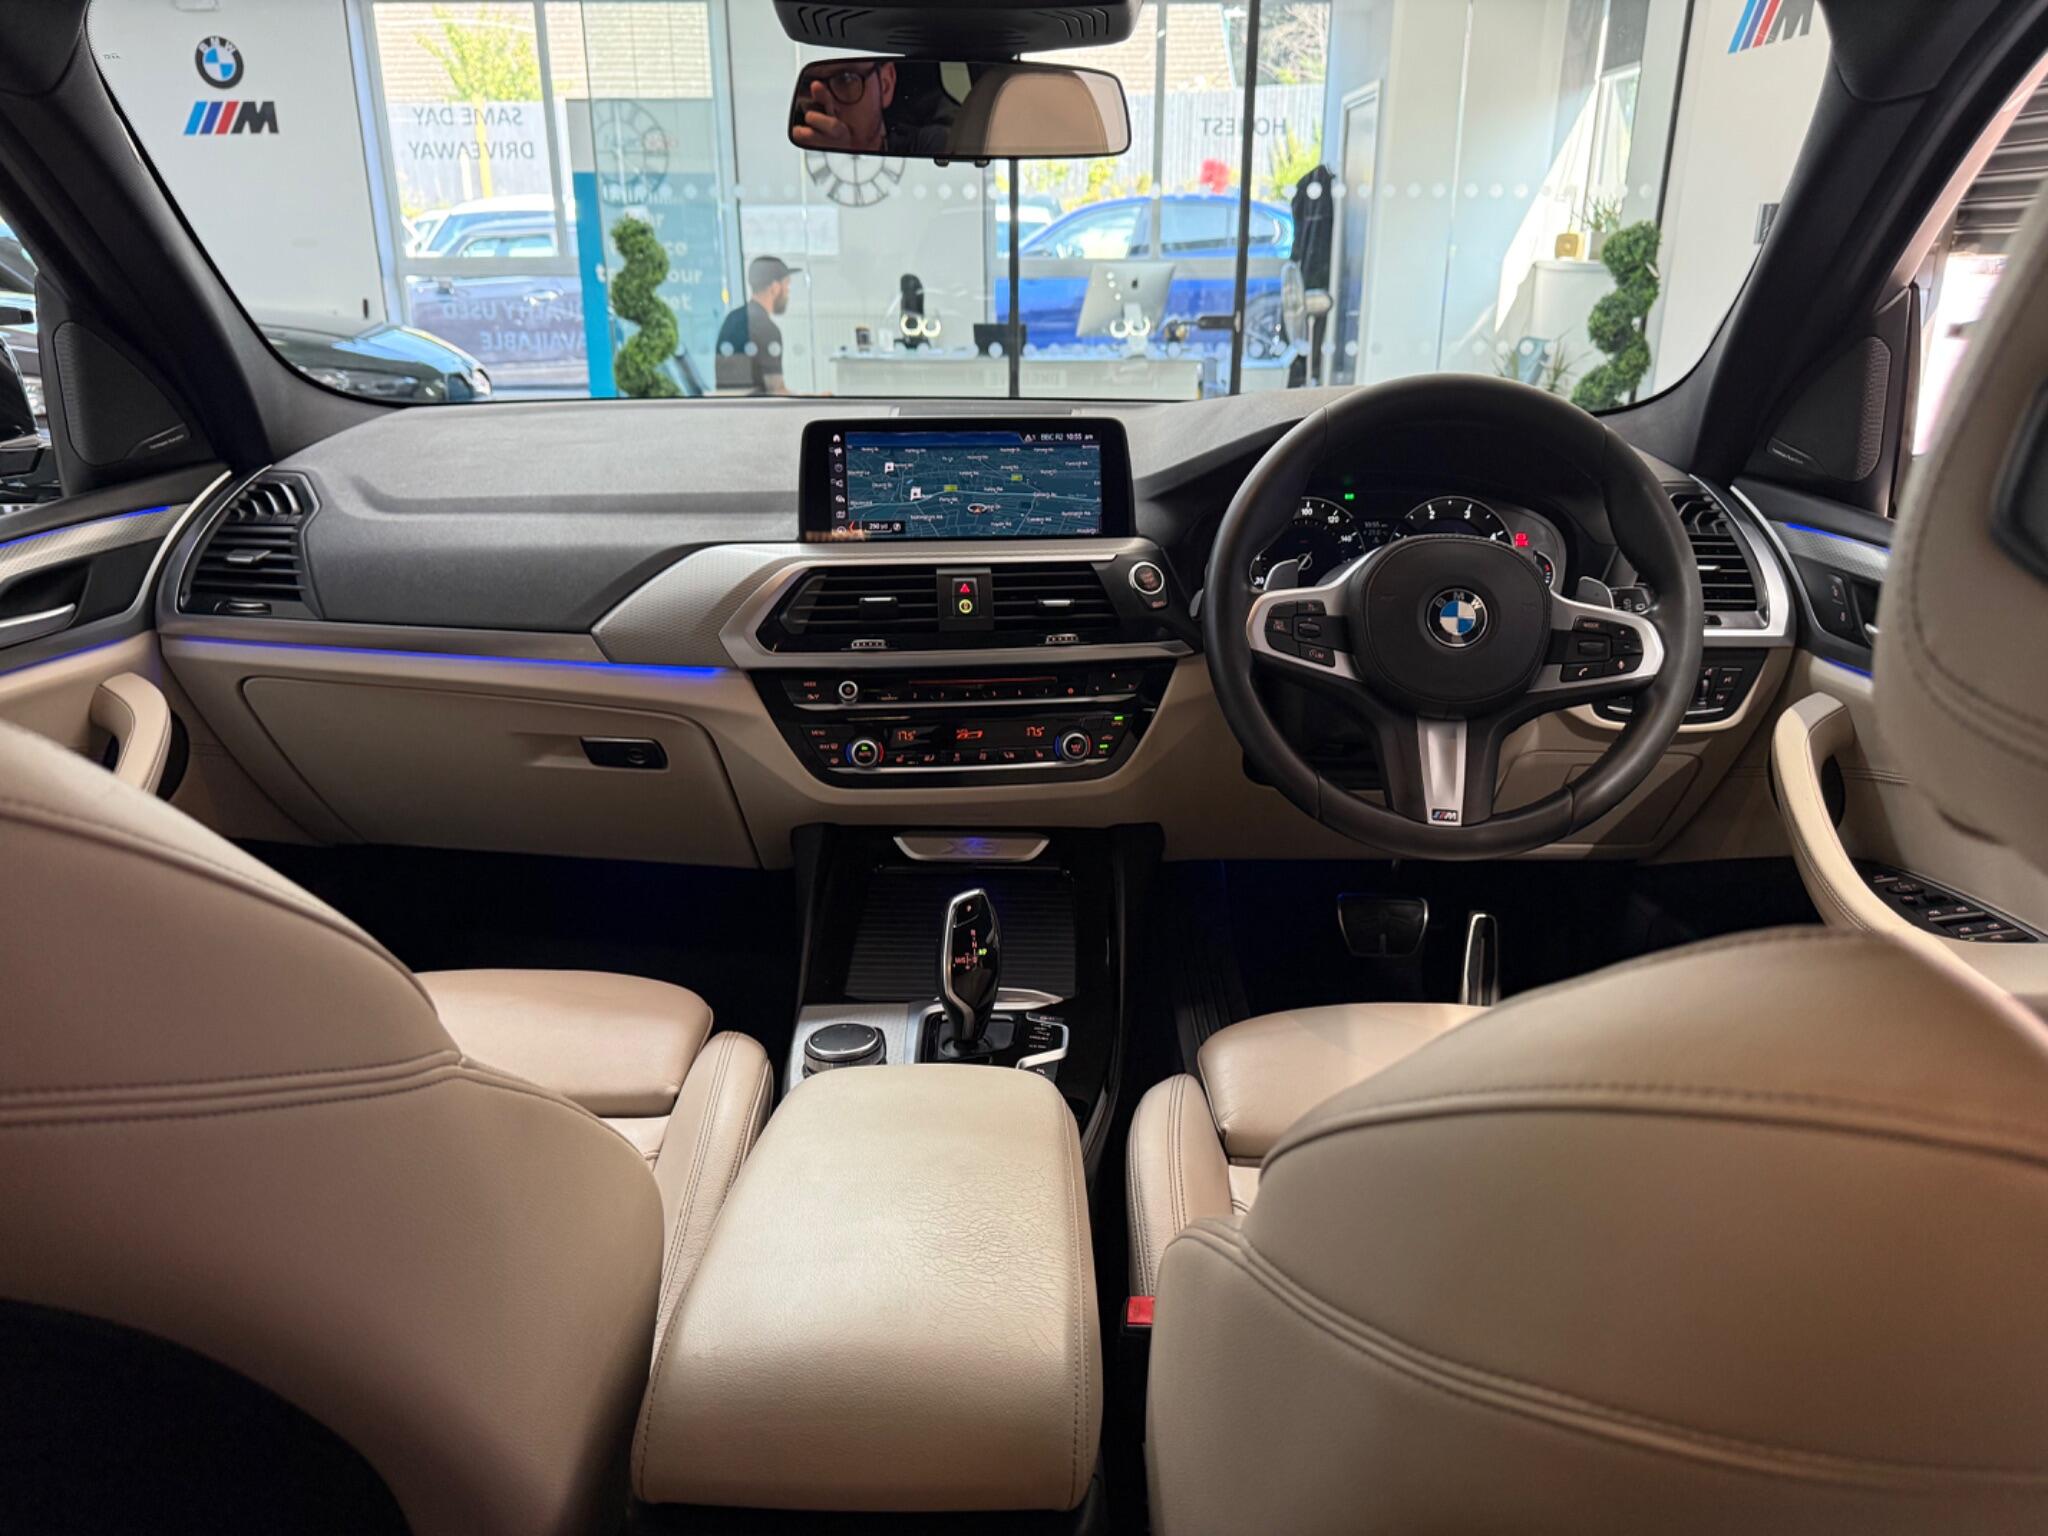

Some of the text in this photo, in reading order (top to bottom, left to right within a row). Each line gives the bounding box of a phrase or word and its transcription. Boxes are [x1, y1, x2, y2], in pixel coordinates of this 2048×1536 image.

[1301, 507, 1313, 516] 100
[1427, 509, 1436, 520] 2
[1463, 509, 1471, 519] 3
[1327, 515, 1340, 524] 120
